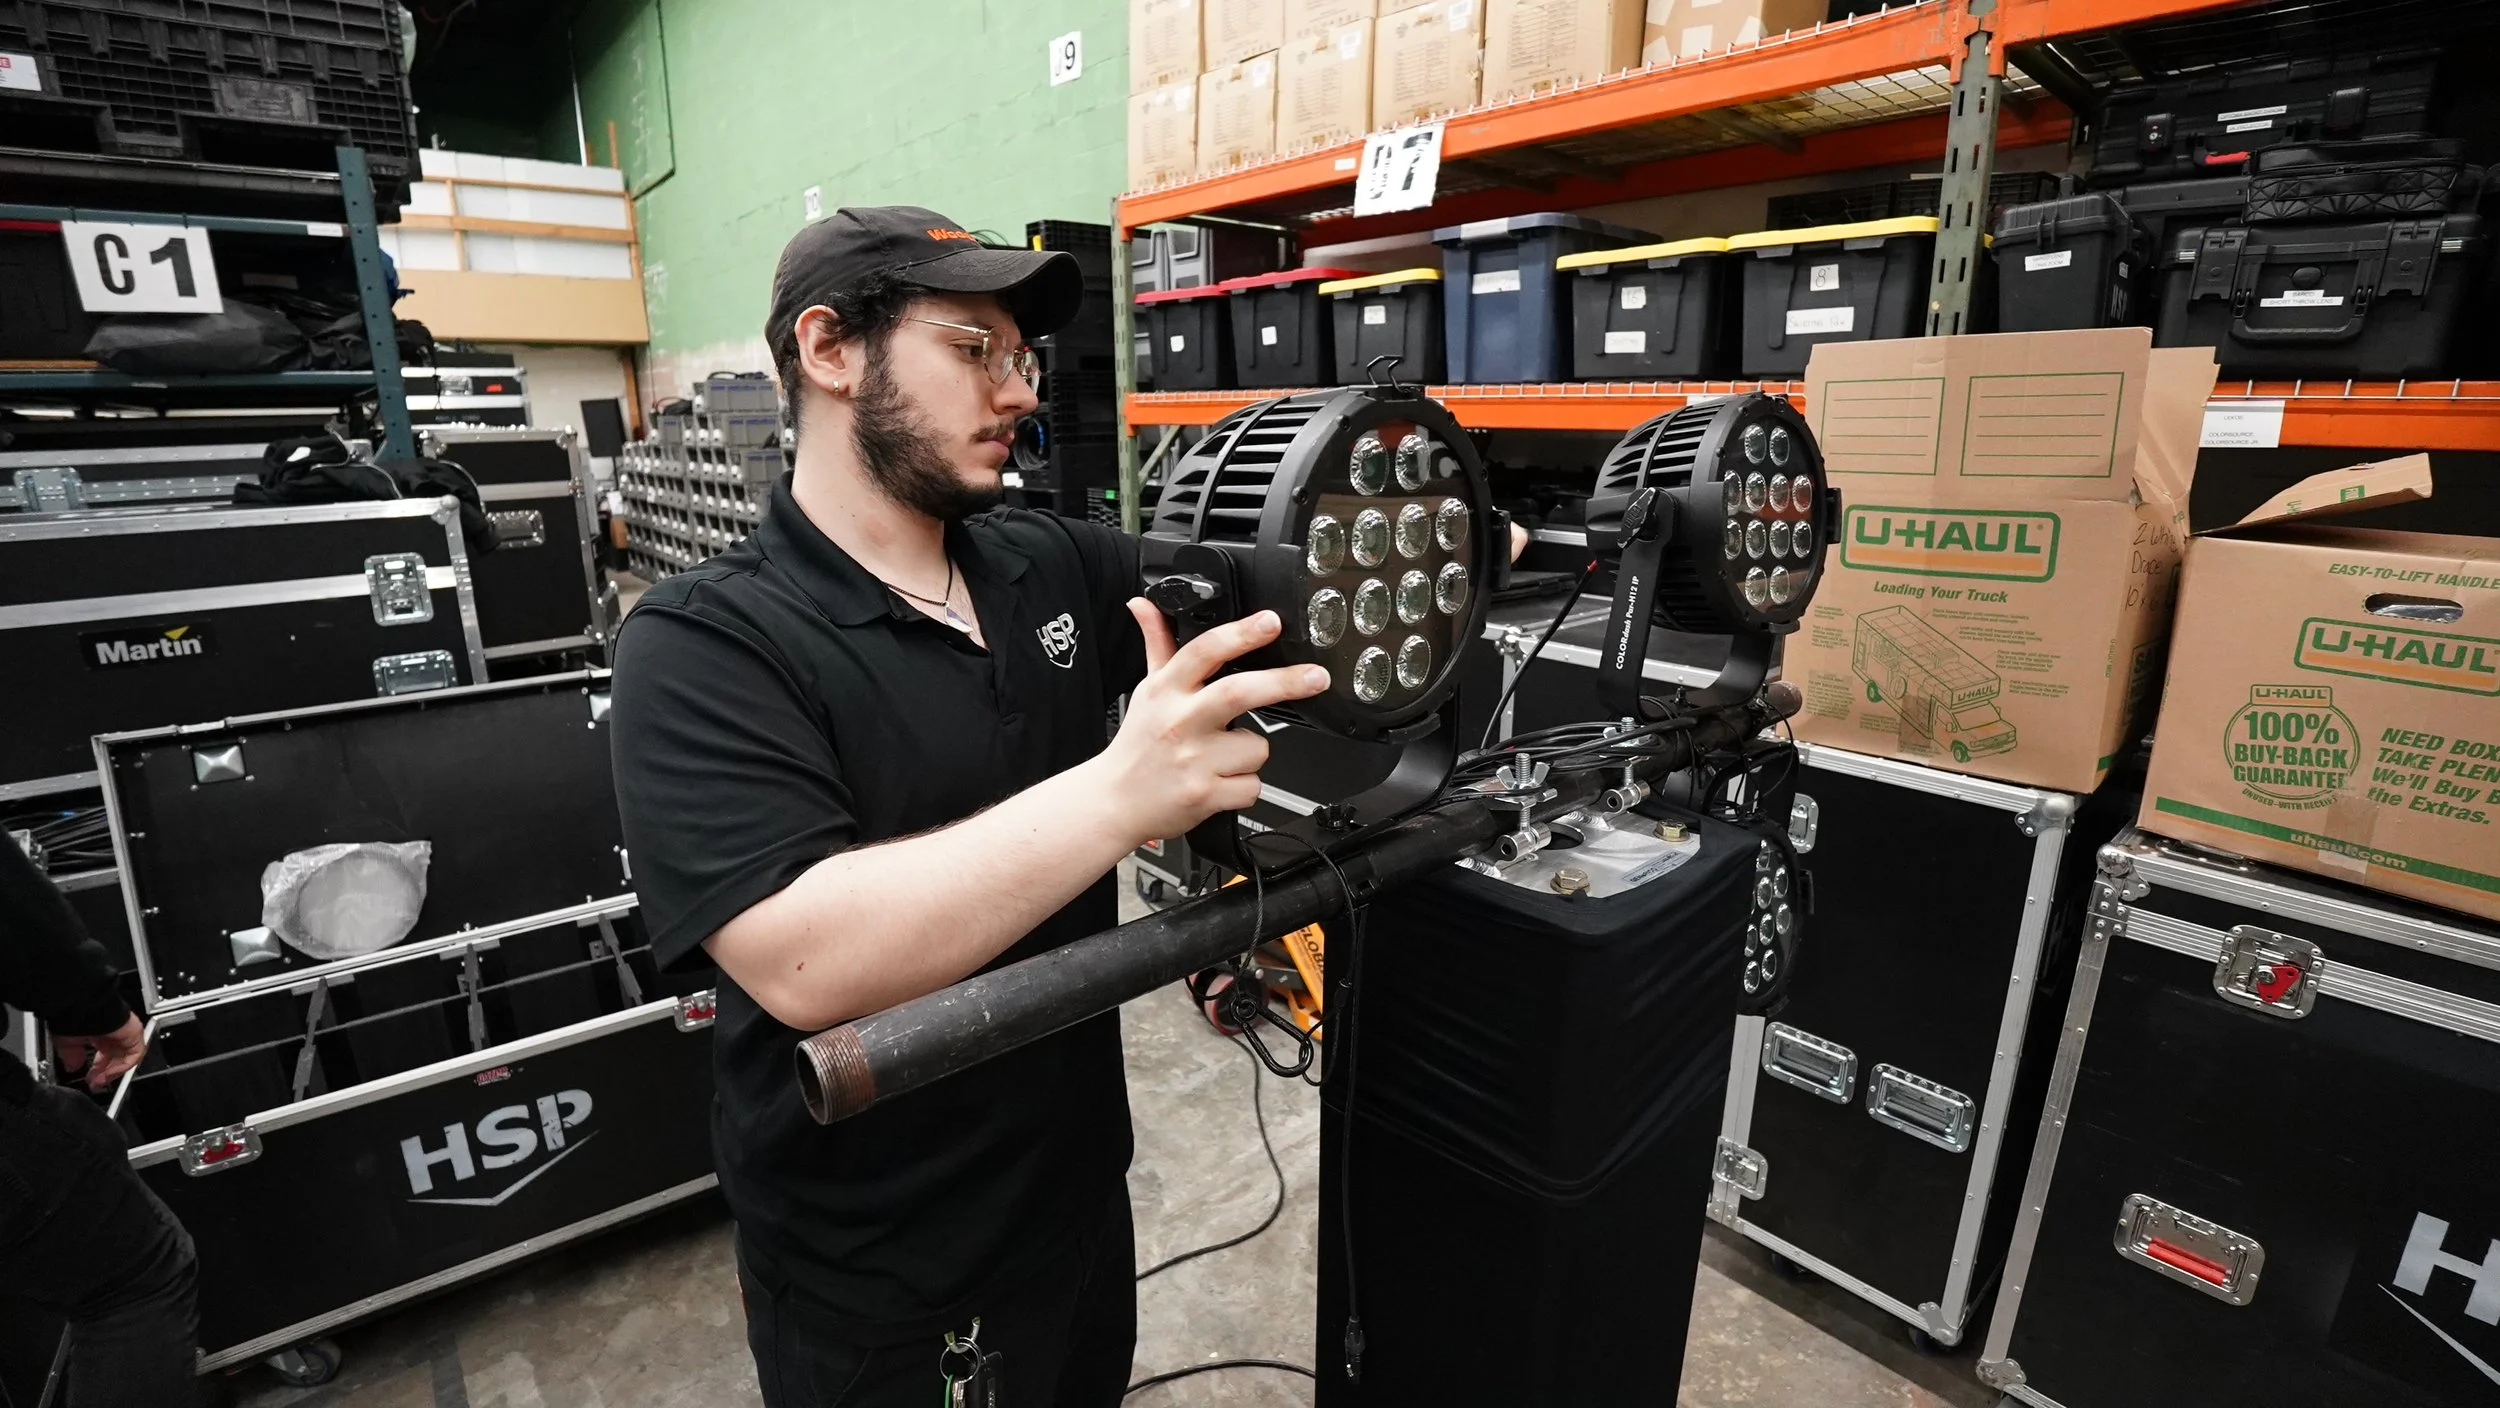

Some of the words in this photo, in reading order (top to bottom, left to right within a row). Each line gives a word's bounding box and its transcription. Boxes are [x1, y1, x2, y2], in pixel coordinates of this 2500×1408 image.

[94, 233, 197, 298] C1
[1855, 515, 2042, 554] U-HAUL
[2328, 563, 2434, 583] EASY-TO-LIFT
[1874, 581, 1925, 599] Loading
[1930, 585, 1962, 600] Your
[1967, 588, 2008, 603] Truck
[96, 637, 202, 664] Martin
[1036, 613, 1075, 658] HSP
[1616, 620, 1632, 670] COLORdash
[2312, 627, 2496, 674] U-HAUL
[2256, 688, 2327, 699] U-HAUL
[2244, 711, 2340, 744] 100%
[2381, 727, 2445, 750] NEED
[2234, 743, 2348, 769] BUY-BACK
[2378, 747, 2436, 771] TAKE
[2372, 766, 2429, 791] We'll
[2432, 779, 2481, 803] Buy
[2368, 786, 2402, 806] the
[2408, 795, 2490, 824] Extras.
[400, 1089, 593, 1195] HSP
